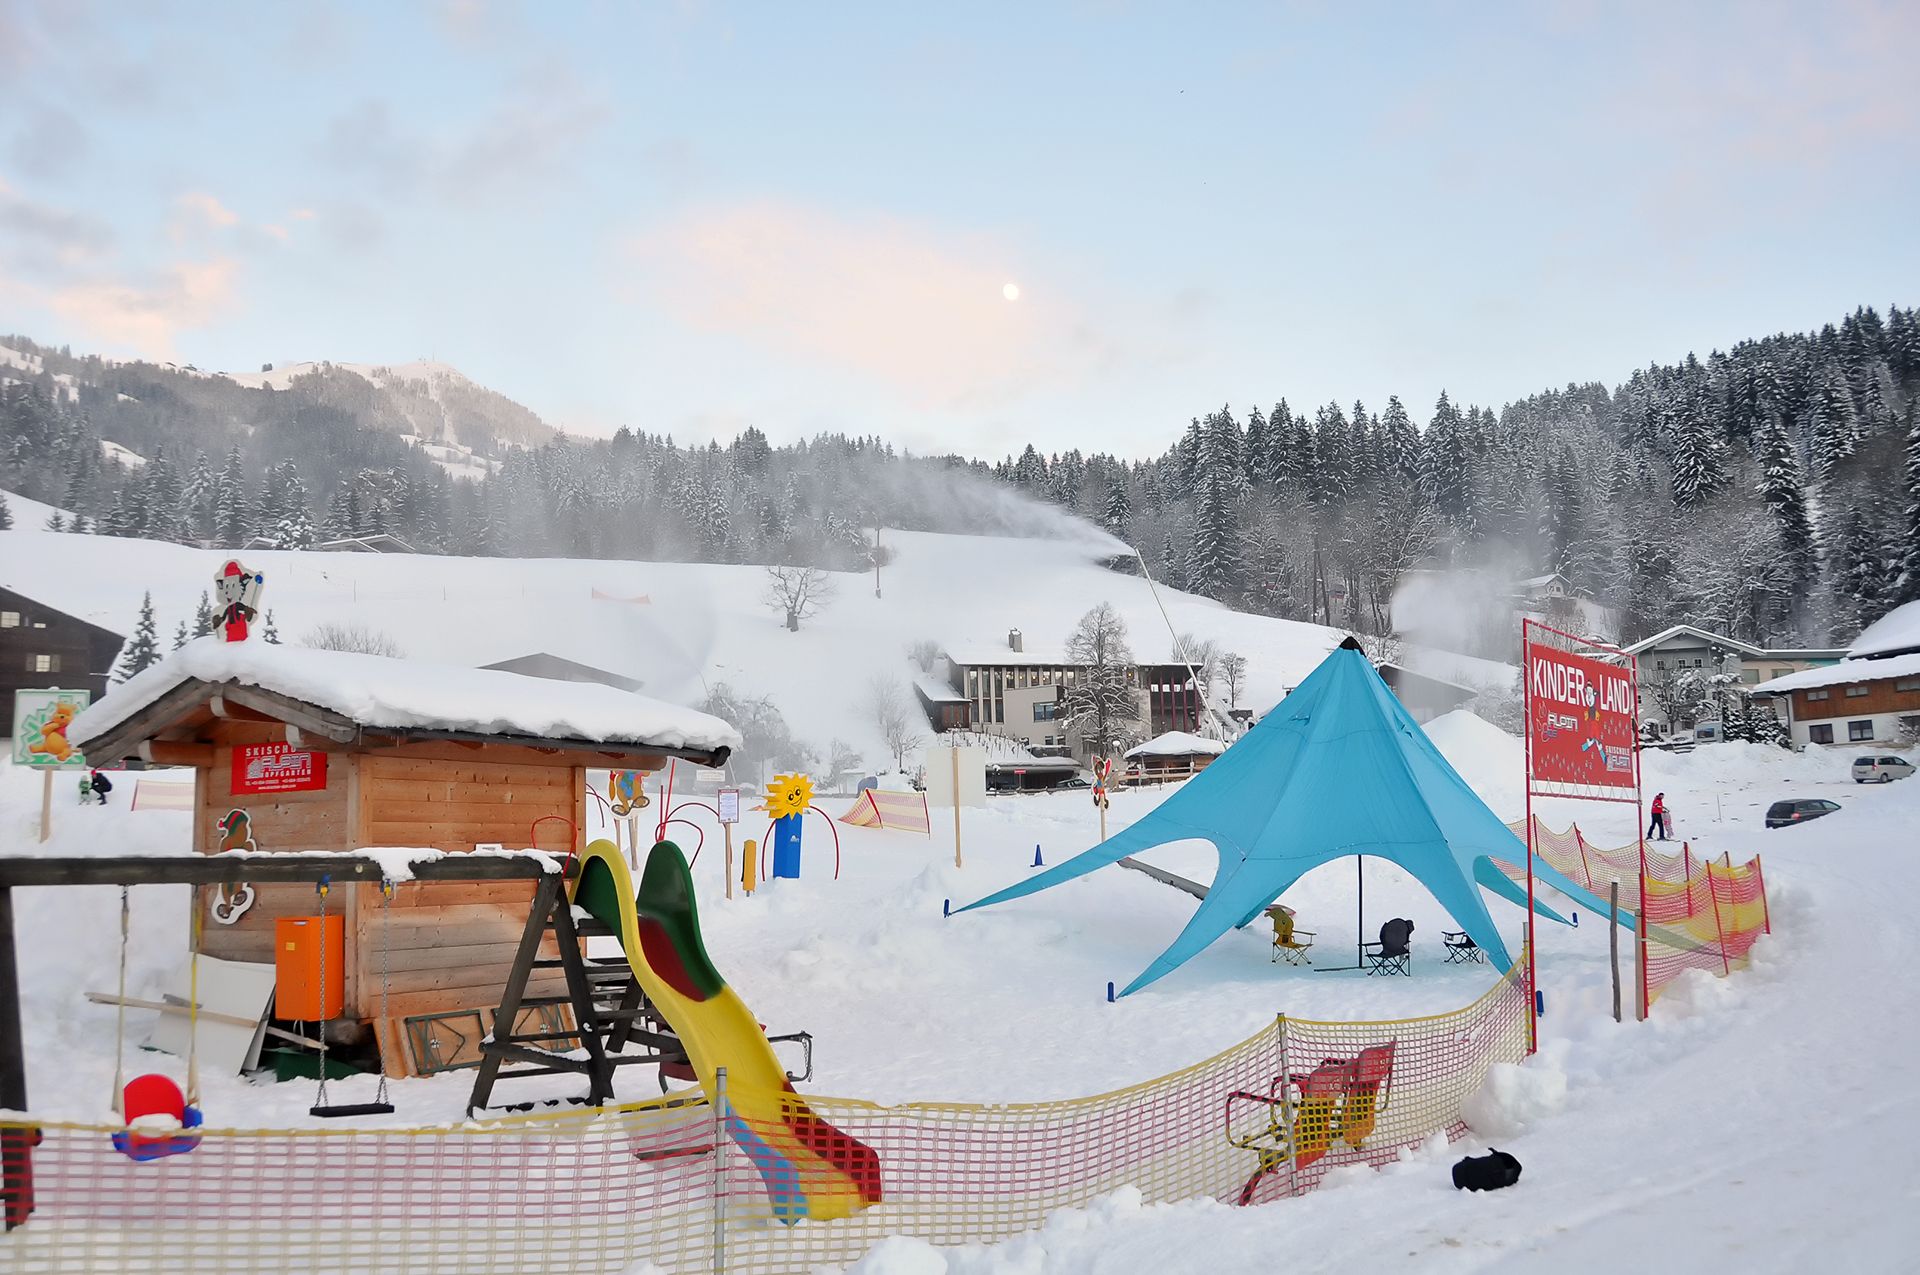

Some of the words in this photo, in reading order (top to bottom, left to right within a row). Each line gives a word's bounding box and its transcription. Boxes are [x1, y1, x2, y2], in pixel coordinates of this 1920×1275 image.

[1533, 656, 1586, 707] KINDER
[1600, 673, 1630, 715] LAND
[245, 744, 297, 757] SKISCHU
